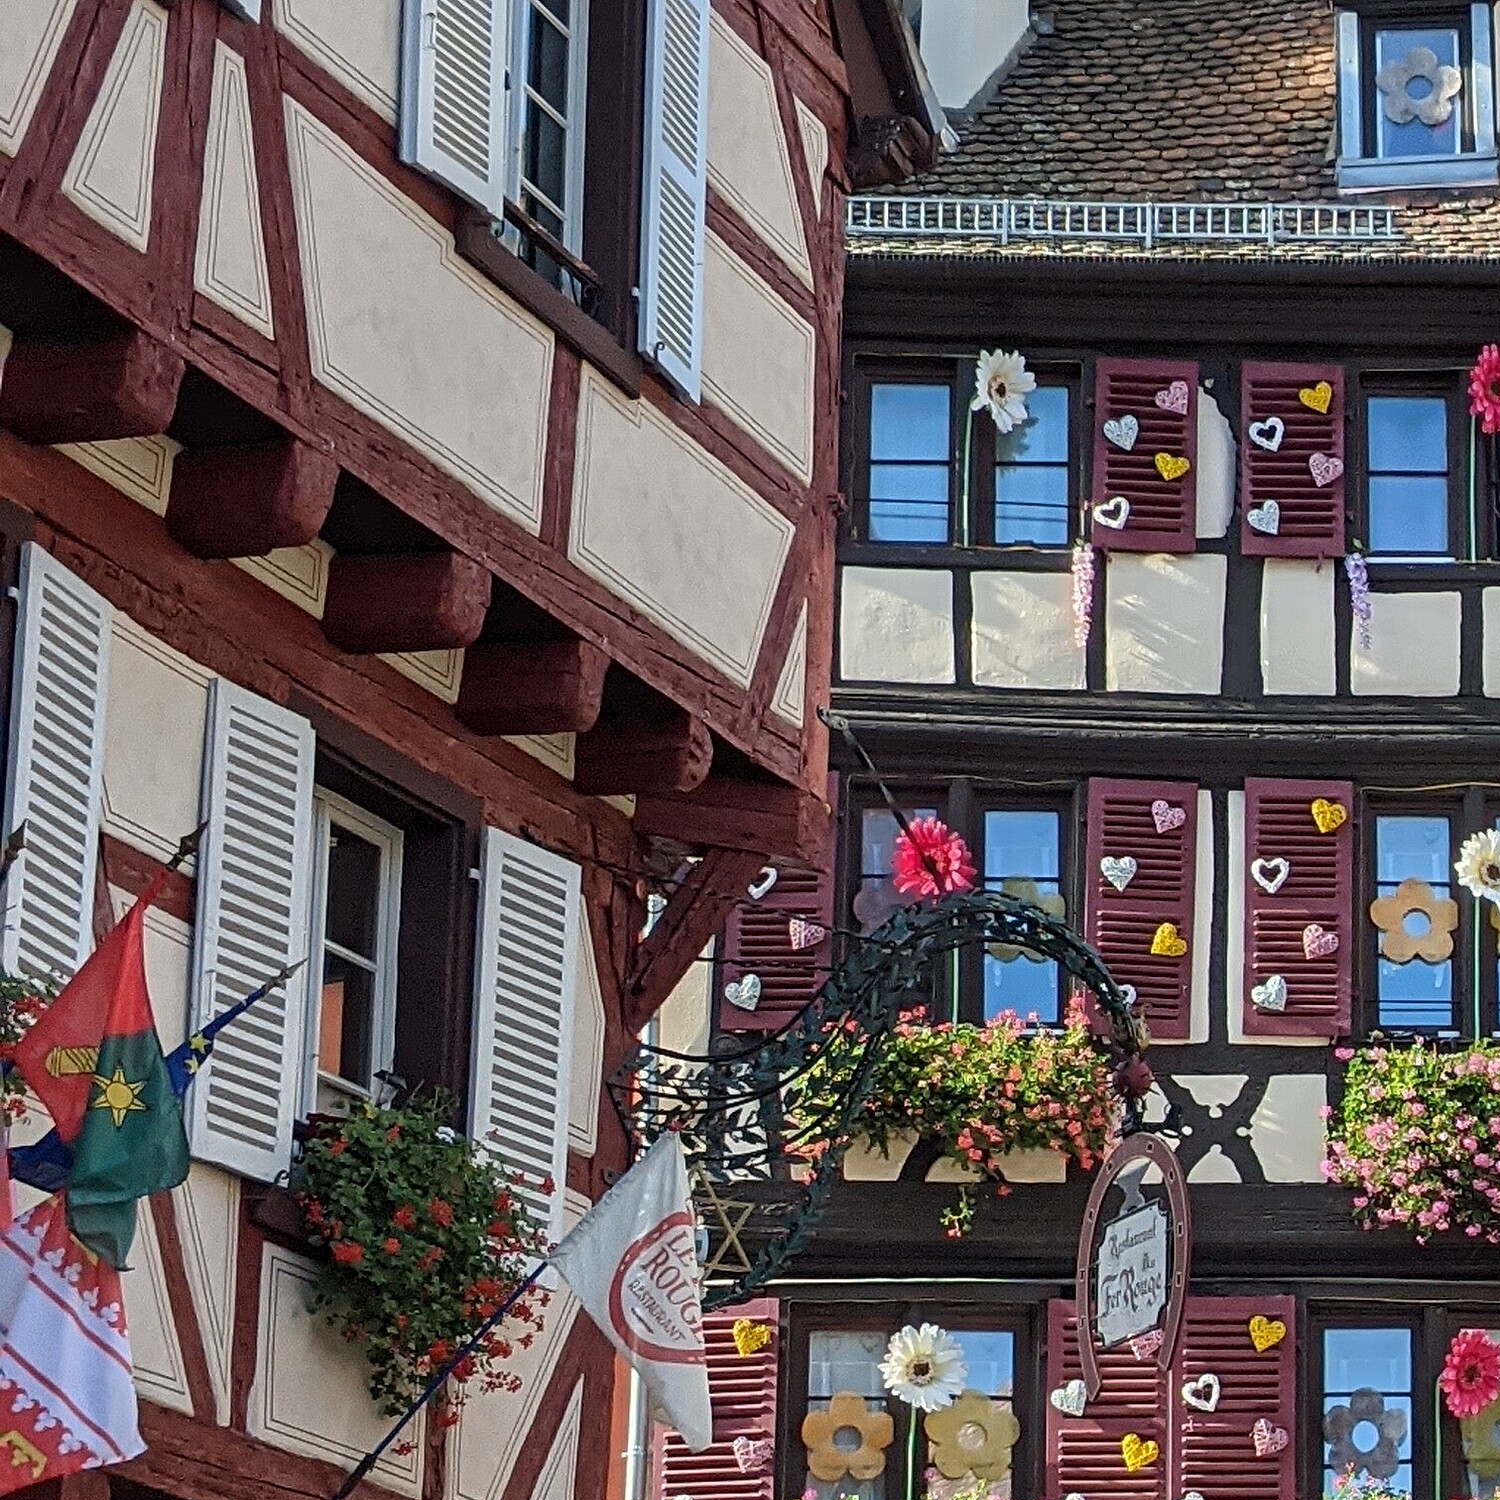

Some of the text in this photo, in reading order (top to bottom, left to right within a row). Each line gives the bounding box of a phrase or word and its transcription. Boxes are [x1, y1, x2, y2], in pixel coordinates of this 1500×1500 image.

[666, 1229, 695, 1268] LE
[628, 1279, 686, 1343] RESTAURANT
[1101, 1266, 1162, 1318] Fer Rouge
